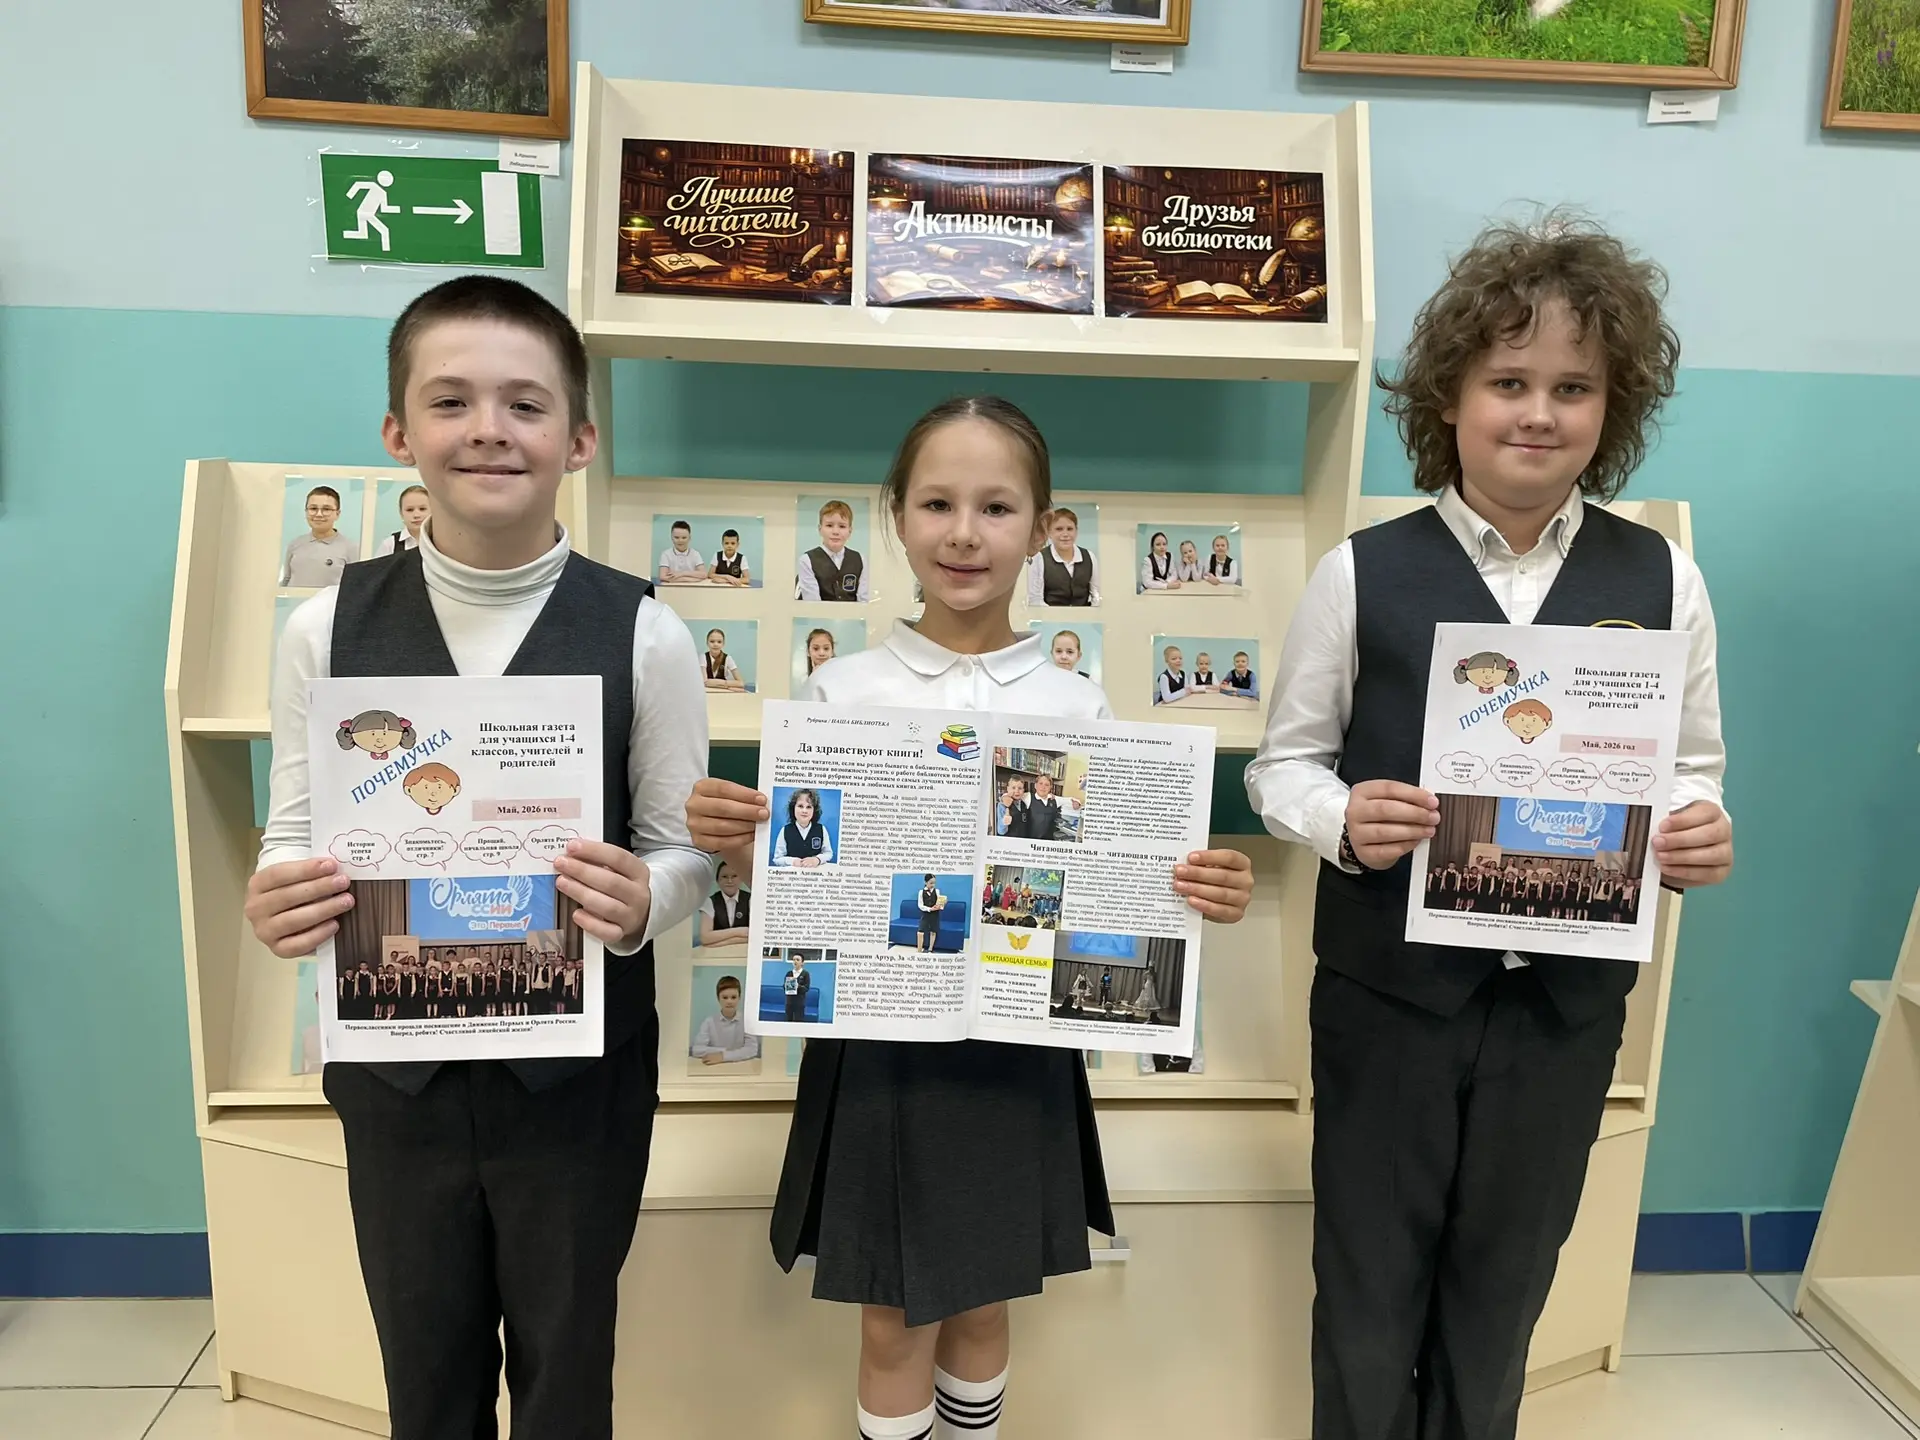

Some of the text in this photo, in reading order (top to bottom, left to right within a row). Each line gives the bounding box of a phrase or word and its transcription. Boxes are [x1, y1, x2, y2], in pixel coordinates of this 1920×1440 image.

[667, 175, 795, 214] Лучшие
[1162, 195, 1257, 227] Друзья
[664, 211, 806, 240] читатели
[893, 200, 1054, 242] Активисты
[1141, 225, 1274, 251] библиотеки
[1574, 666, 1660, 680] Школьная газета
[1573, 679, 1591, 688] для
[1593, 680, 1642, 690] учащихся
[1459, 670, 1550, 731] ПОЧЕМУЧКА
[1564, 689, 1606, 699] классов,
[1608, 690, 1654, 701] учителей
[1588, 700, 1639, 711] родителей
[479, 721, 576, 734] Школьная газета
[783, 719, 789, 728] 2
[478, 733, 576, 747] для учащихся 1-4
[1581, 740, 1636, 752] Май, 2026 год
[471, 744, 584, 758] классов, учителей и
[797, 742, 923, 759] Да здравствуют книги!
[350, 728, 452, 804] ПОЧЕМУЧКА
[499, 757, 556, 770] родителей
[497, 804, 558, 816] Май, 2026 год
[1030, 843, 1073, 855] Читающая
[1074, 848, 1099, 857] семья
[1106, 851, 1149, 861] читающая
[1149, 854, 1178, 863] страна
[985, 955, 1048, 967] ЧИТАЮЩАЯ СЕМЬЯ
